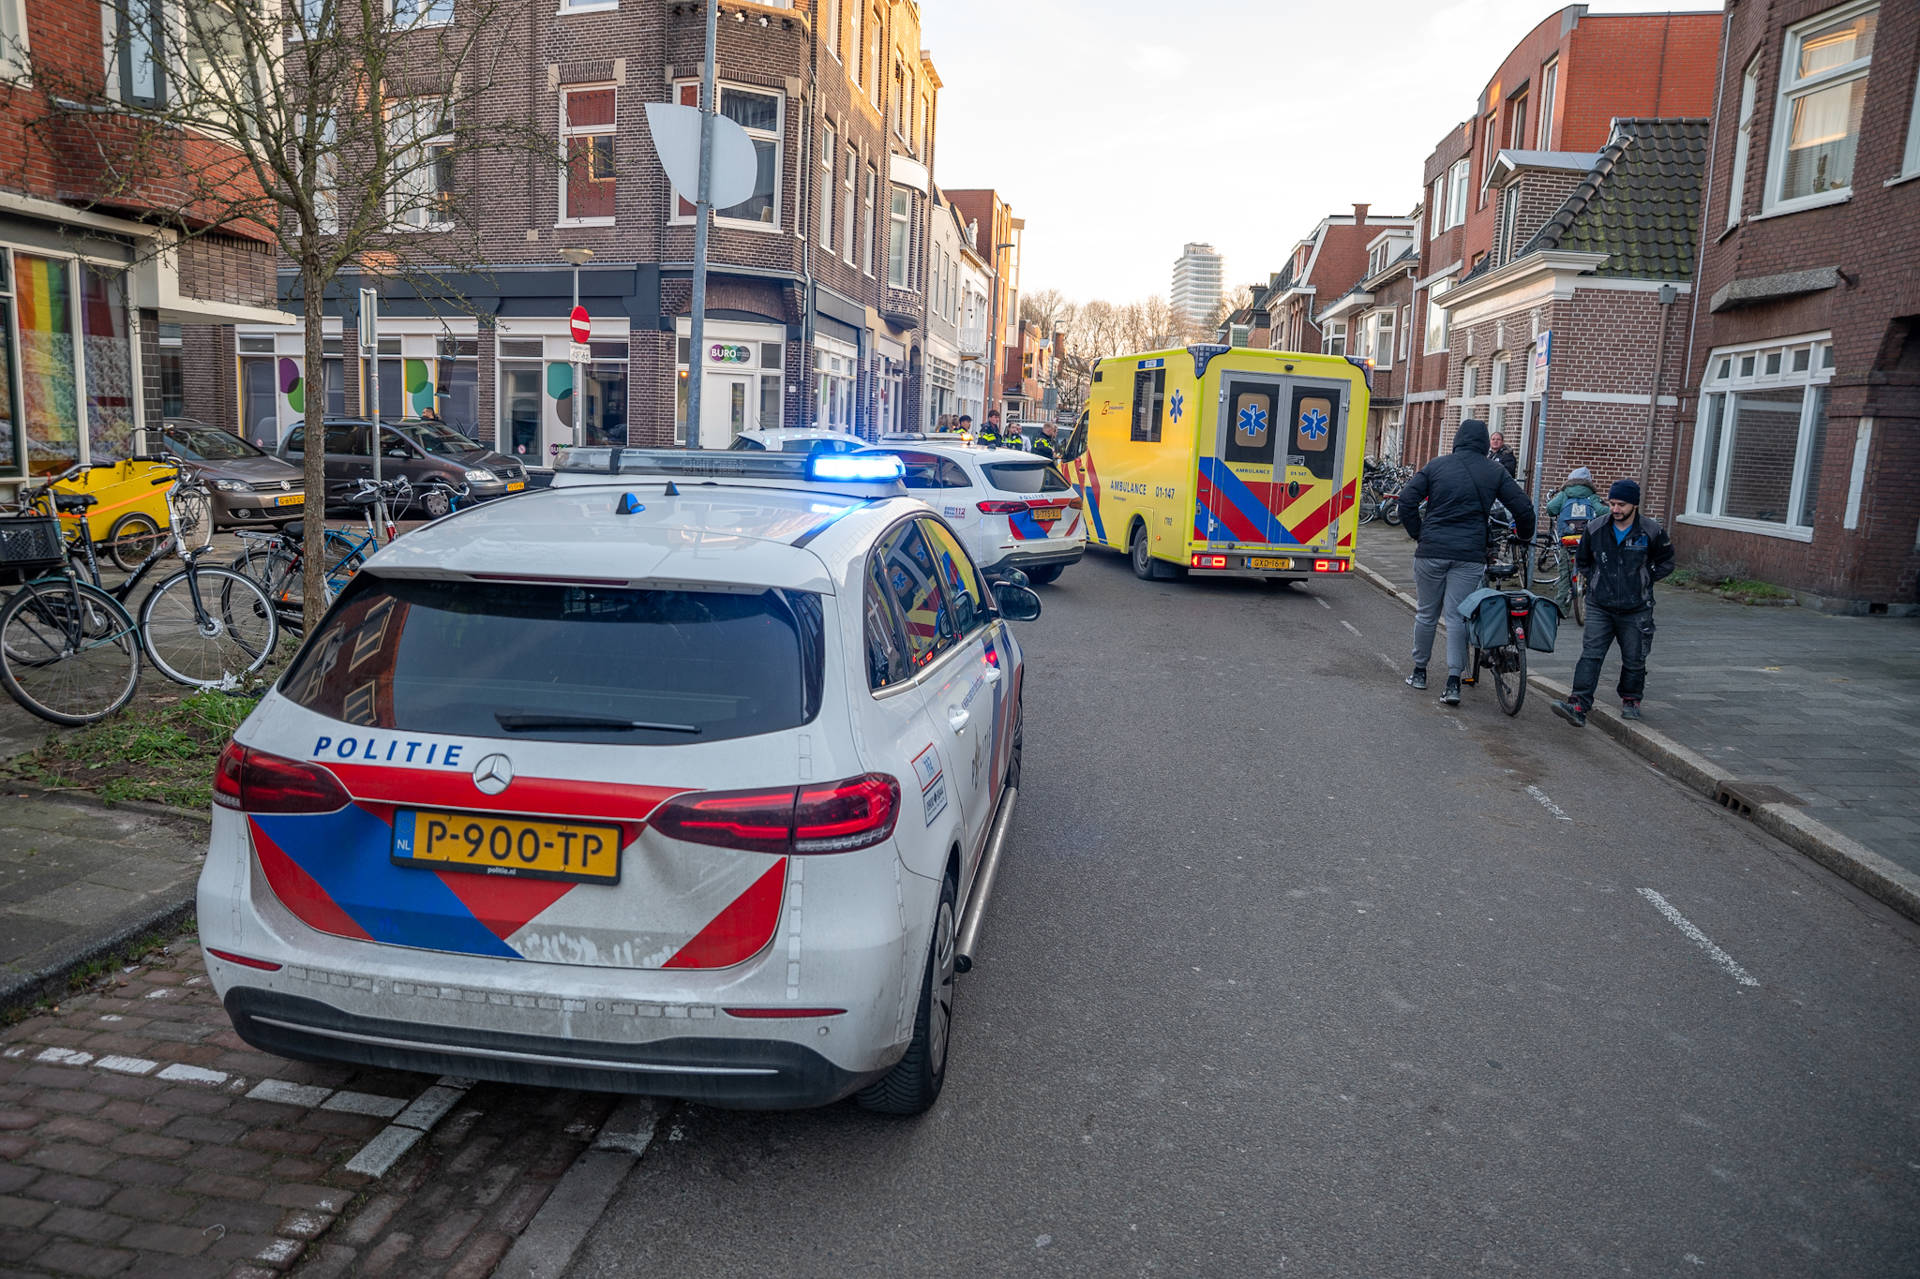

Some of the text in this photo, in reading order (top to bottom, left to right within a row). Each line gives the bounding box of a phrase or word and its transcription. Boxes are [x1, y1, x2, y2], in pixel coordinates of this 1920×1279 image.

[711, 348, 737, 358] BURO
[1235, 467, 1270, 475] AMBULANCE
[1110, 480, 1176, 500] AMBULANCE 01-147
[313, 736, 463, 767] POLITIE
[396, 838, 411, 852] NL
[426, 819, 604, 868] P-900-TP
[487, 866, 517, 876] politie.nl
